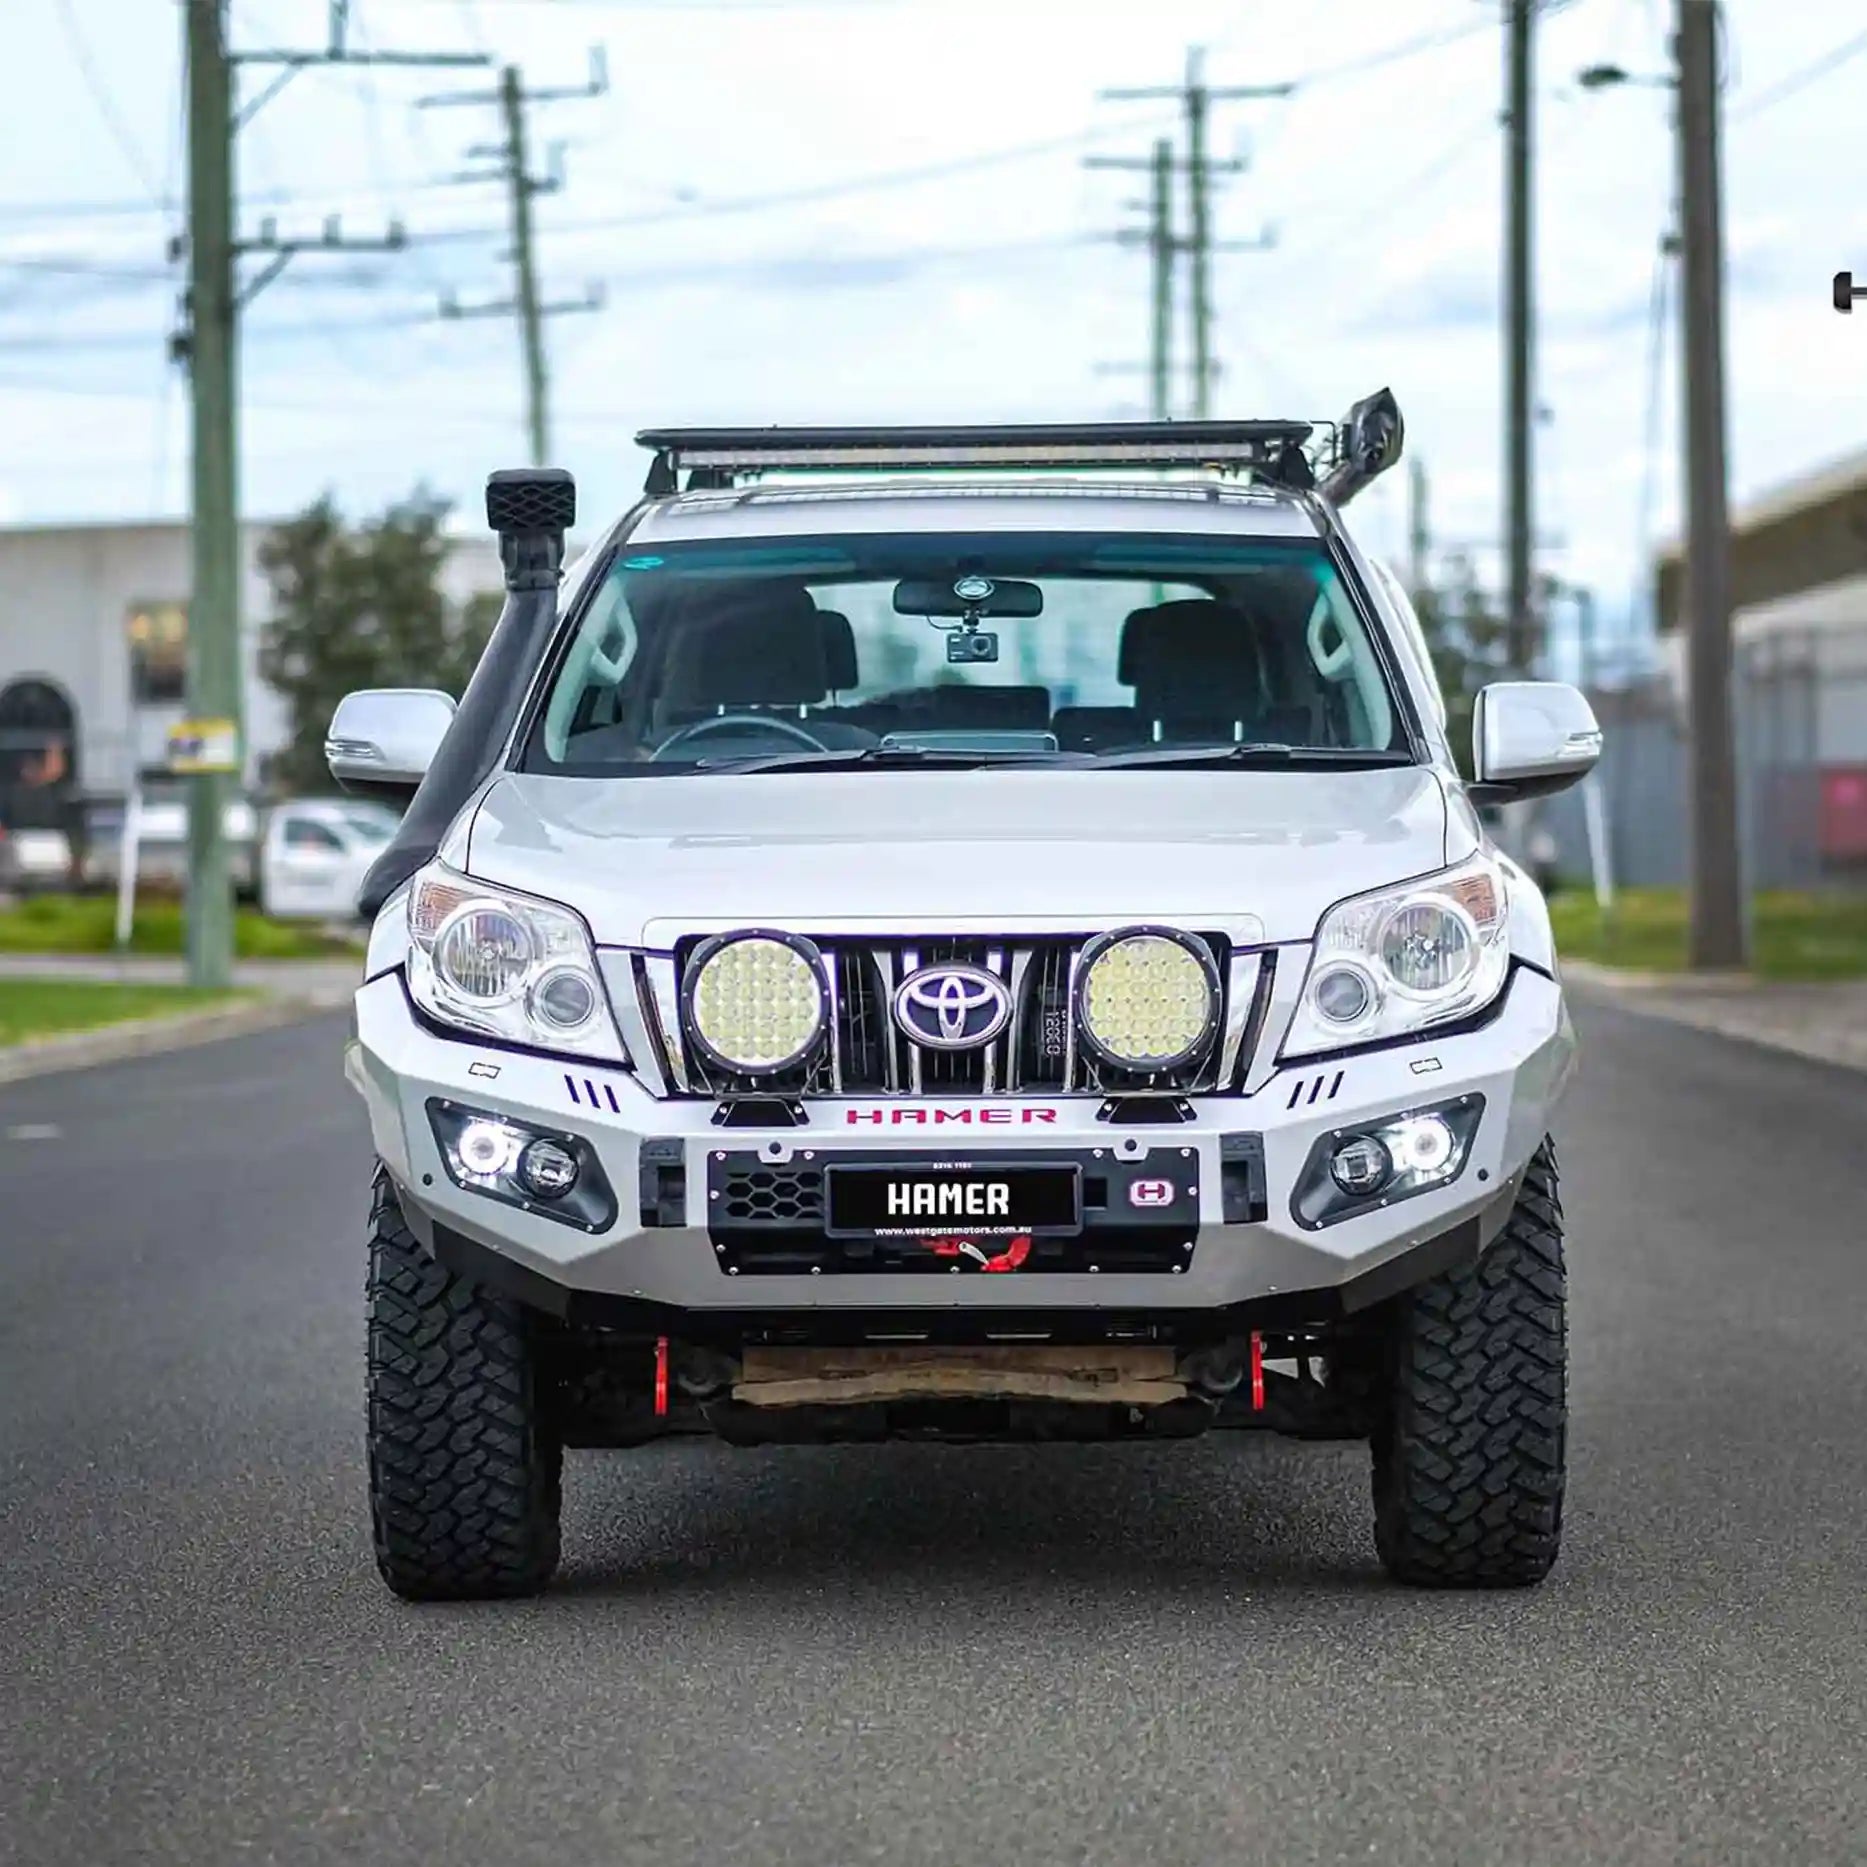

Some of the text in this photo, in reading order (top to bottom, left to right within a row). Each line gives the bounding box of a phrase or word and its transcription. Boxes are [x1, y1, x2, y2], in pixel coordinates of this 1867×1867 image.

[847, 1108, 1057, 1125] HAMER
[887, 1183, 1009, 1215] HAMER
[874, 1226, 1032, 1237] www.westgatemotors.com.au
